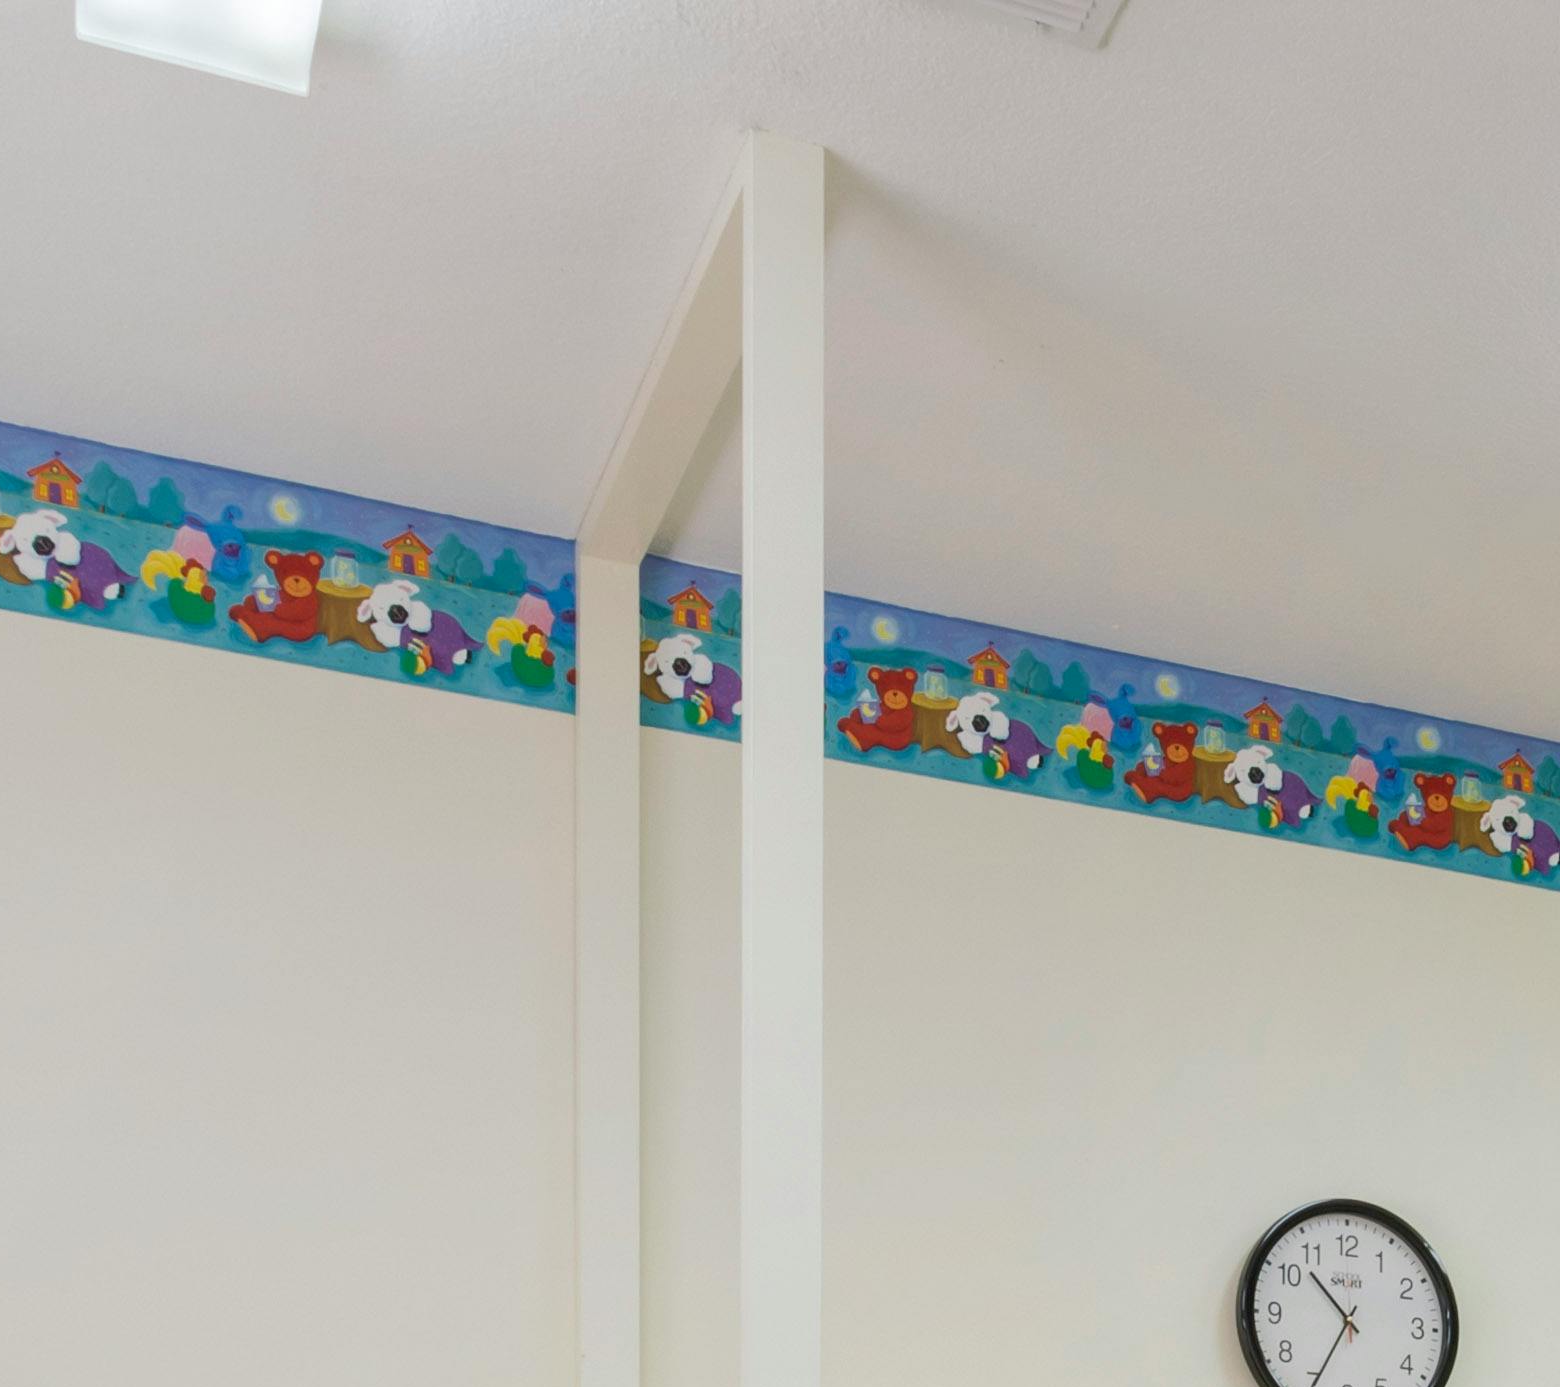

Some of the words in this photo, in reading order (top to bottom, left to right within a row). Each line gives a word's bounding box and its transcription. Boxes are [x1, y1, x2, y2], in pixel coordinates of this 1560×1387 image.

[1301, 1242, 1322, 1266] 11
[1335, 1234, 1359, 1258] 12
[1375, 1251, 1384, 1273] 1
[1278, 1263, 1302, 1287] 10
[1399, 1278, 1414, 1300] 2
[1267, 1301, 1282, 1325] 9
[1411, 1317, 1425, 1340] 3
[1278, 1340, 1293, 1363] 8
[1399, 1354, 1414, 1376] 4
